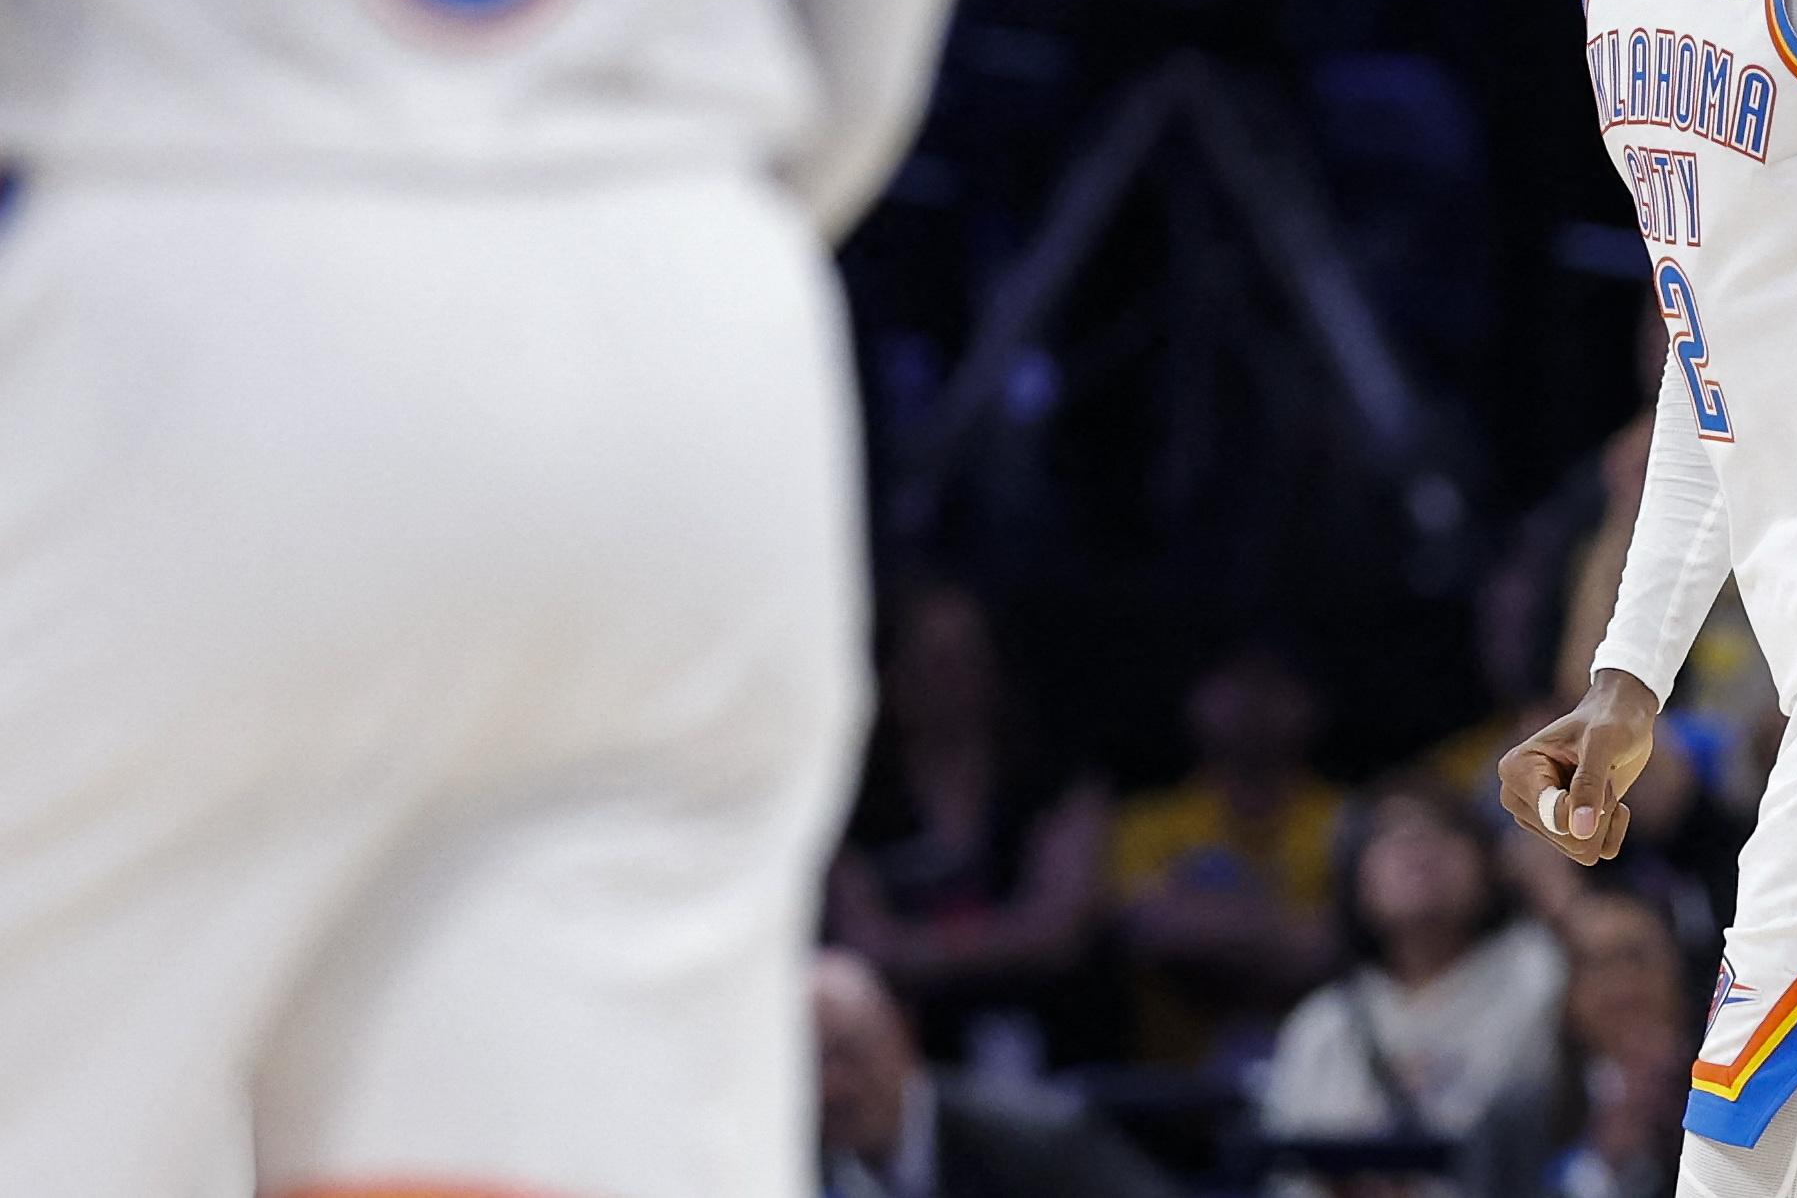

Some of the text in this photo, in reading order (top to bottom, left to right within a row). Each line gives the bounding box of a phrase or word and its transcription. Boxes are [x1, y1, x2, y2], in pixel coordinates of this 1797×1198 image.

[1587, 27, 1777, 163] KLAHOMA
[1623, 144, 1701, 248] CITY
[1654, 256, 1735, 443] 2
